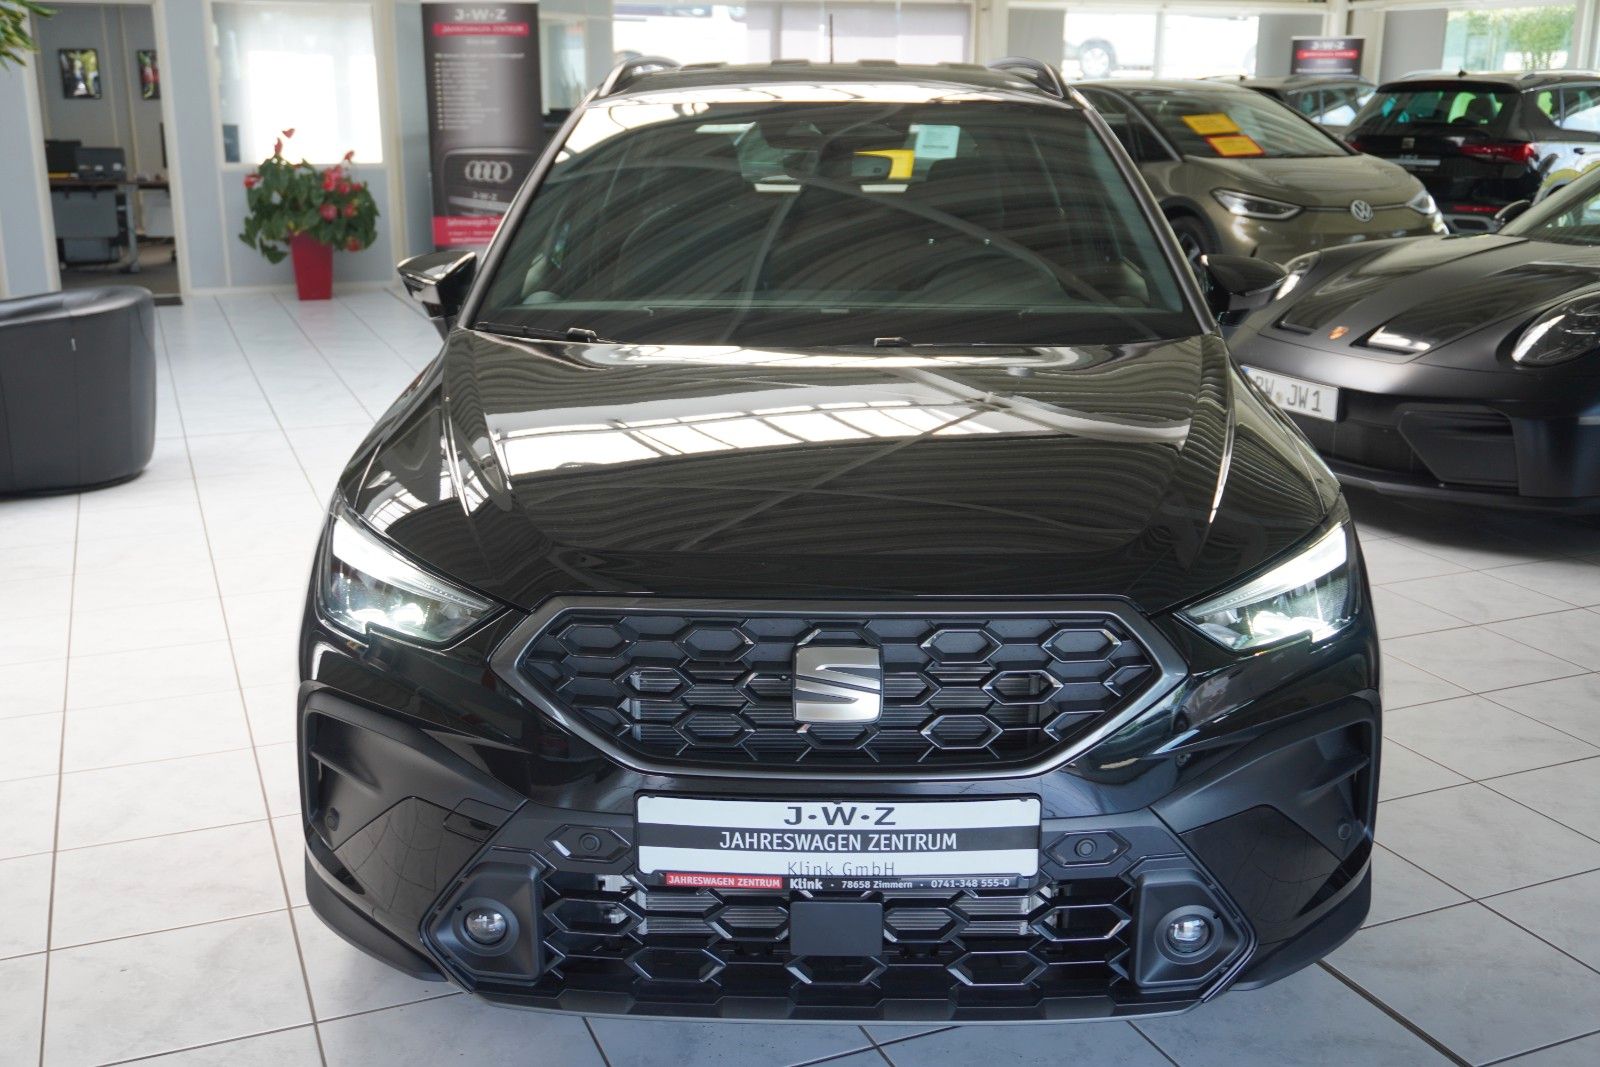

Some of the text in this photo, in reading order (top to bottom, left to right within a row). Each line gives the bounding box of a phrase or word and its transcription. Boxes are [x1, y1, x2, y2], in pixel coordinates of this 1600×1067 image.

[719, 832, 957, 851] JAHRESWAGEN ZENTRUM
[787, 861, 895, 875] Klink GmbH
[668, 875, 780, 887] JAHRESWAGEN ZENTRUM
[789, 878, 1010, 889] Klink 78658 Zimmern 0741-348 555-0
